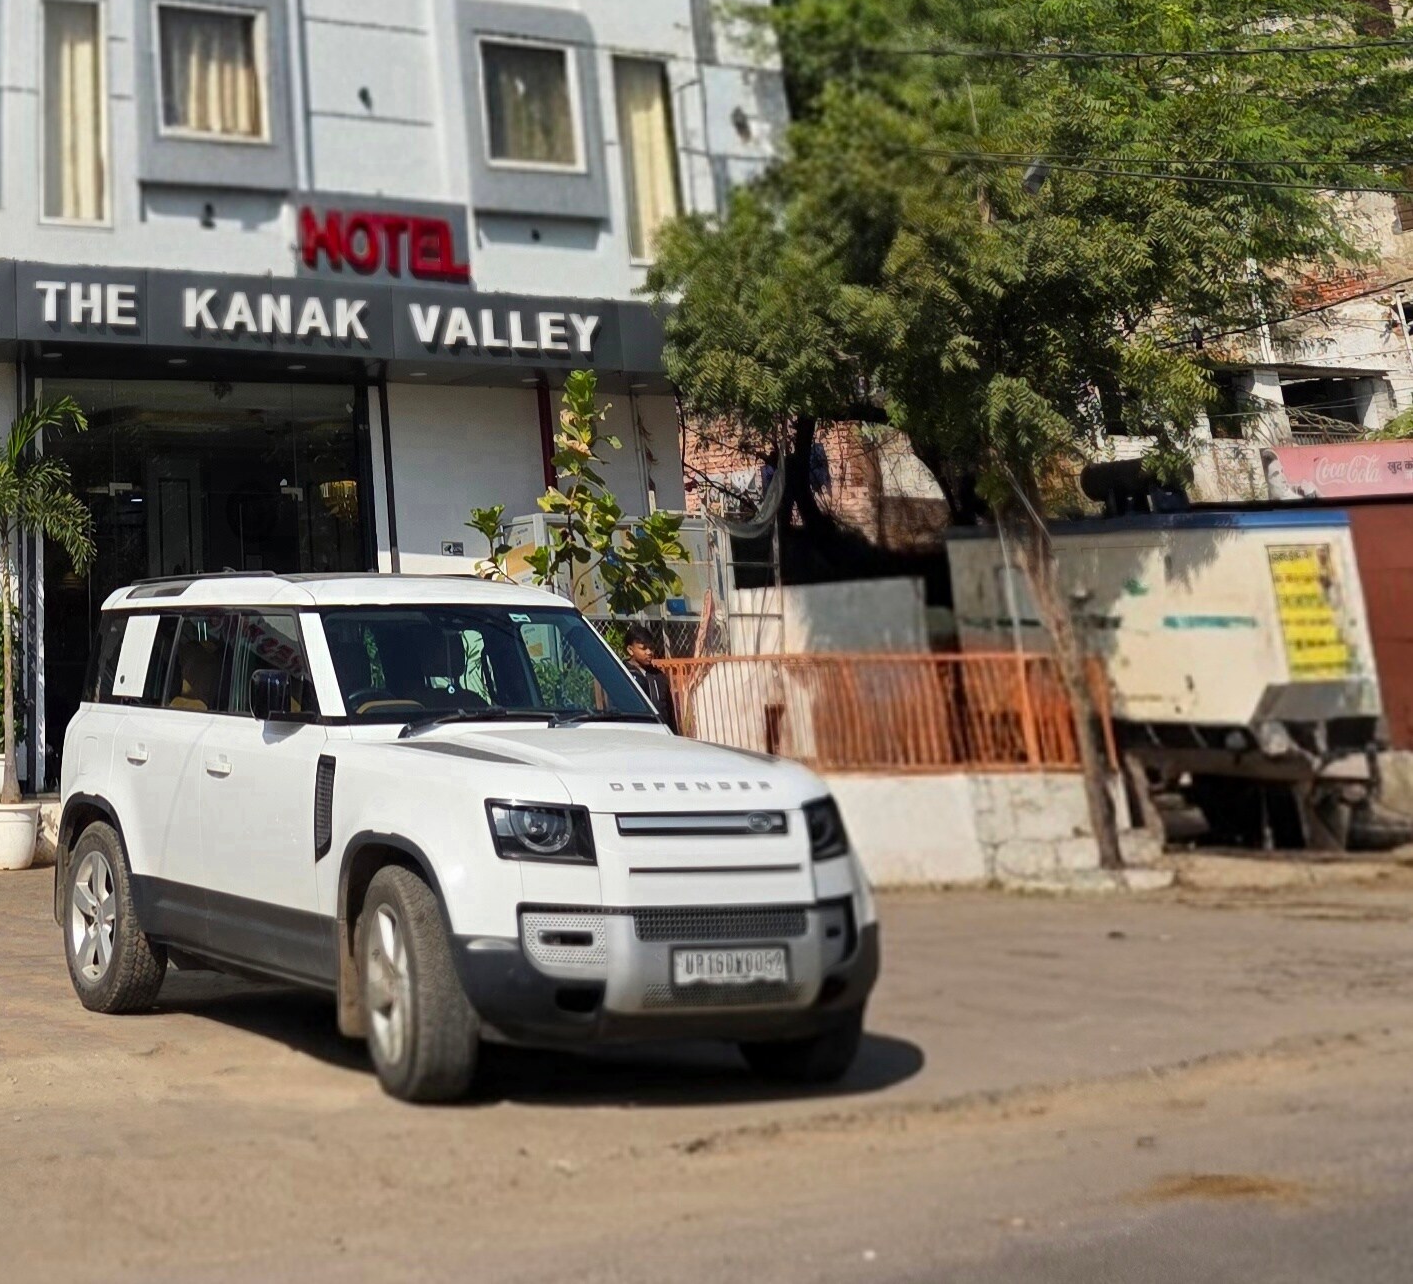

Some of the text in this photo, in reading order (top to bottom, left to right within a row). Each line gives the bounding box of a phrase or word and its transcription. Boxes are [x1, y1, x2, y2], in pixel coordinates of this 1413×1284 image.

[299, 206, 471, 283] HOTEL
[35, 280, 603, 354] THE KANAK VALLEY
[609, 781, 772, 792] DEFENDER
